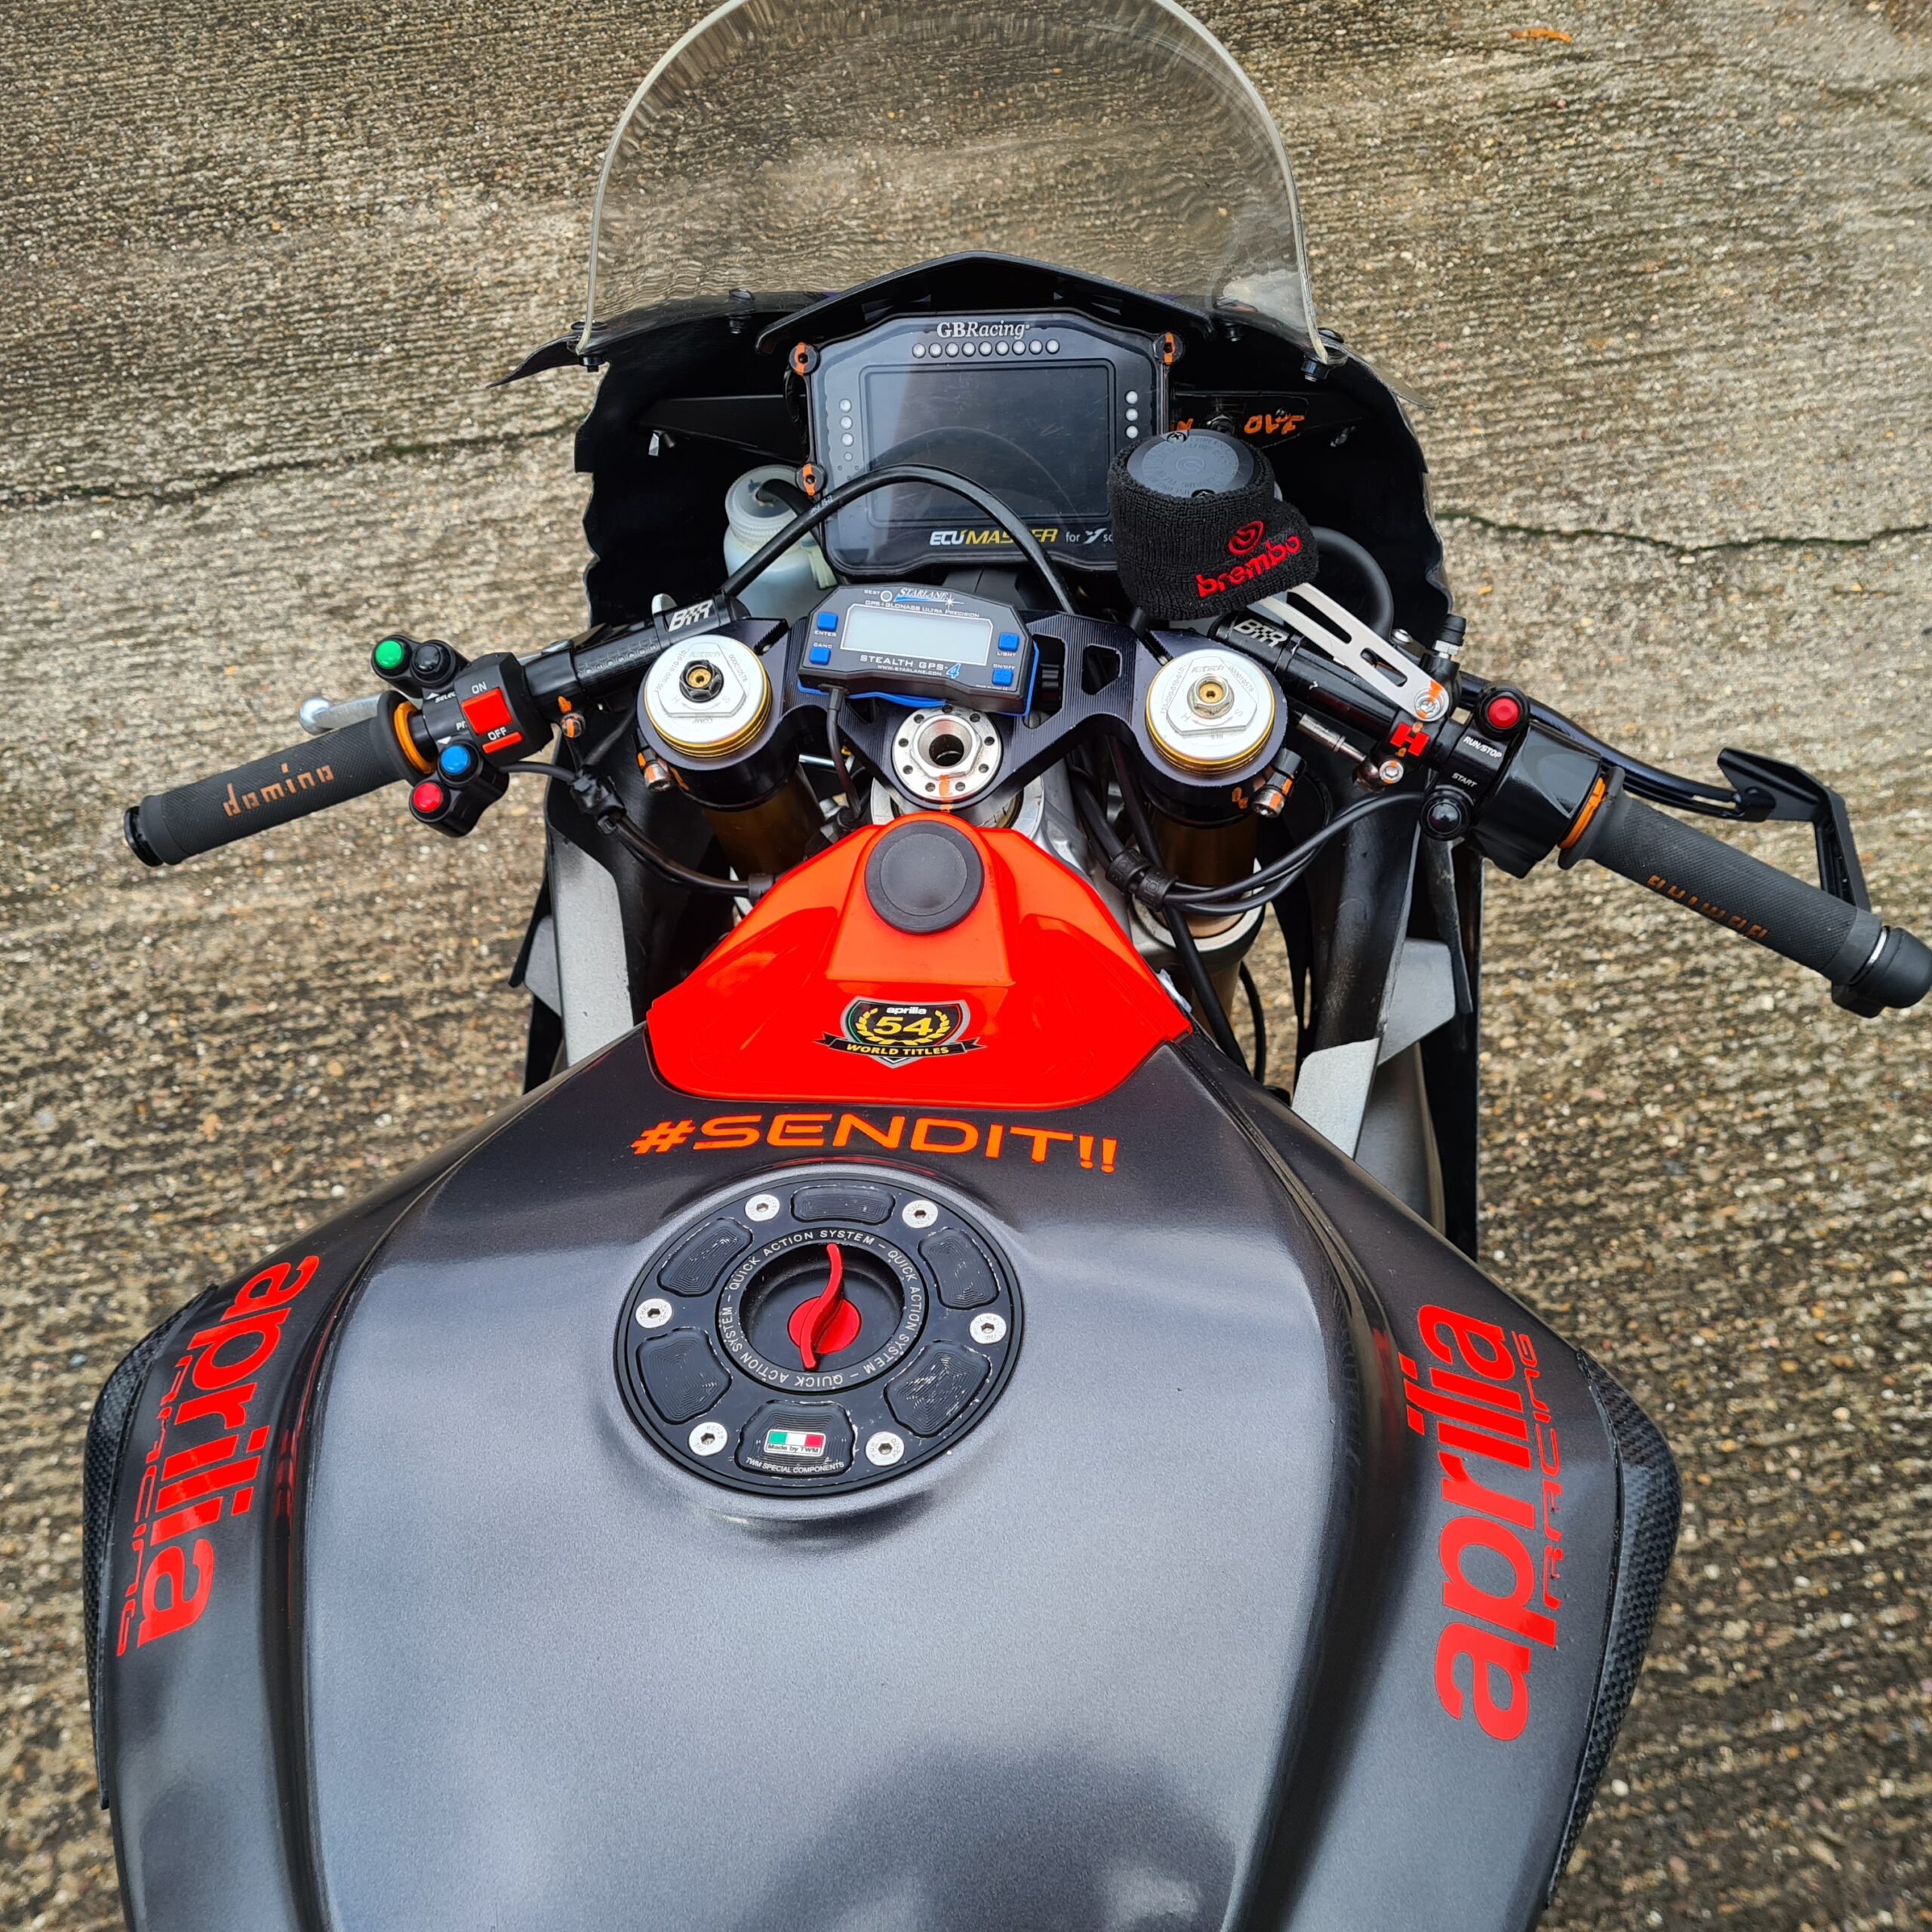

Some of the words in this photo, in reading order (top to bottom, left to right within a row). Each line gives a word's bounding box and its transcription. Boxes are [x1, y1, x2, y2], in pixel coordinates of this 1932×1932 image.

[937, 319, 1026, 340] GBRacing
[1065, 531, 1081, 543] for
[1195, 535, 1302, 598] brembo
[898, 587, 949, 600] STARLANE
[668, 599, 714, 632] BTR
[1233, 618, 1287, 648] BTR
[860, 654, 913, 668] STEALTH
[471, 681, 488, 695] ON
[487, 726, 508, 741] OFF
[1463, 735, 1503, 759] RUN/STOP
[1451, 771, 1478, 789] START
[886, 1006, 928, 1016] aprilia
[873, 1016, 934, 1036] 54
[846, 1043, 899, 1056] WORLD
[903, 1047, 949, 1056] TITLES
[631, 1112, 1118, 1174] #SENDIT!!
[762, 1231, 814, 1257] ACTION
[820, 1229, 875, 1246] SYSTEM
[728, 1257, 761, 1291] QUICK
[887, 1250, 918, 1282] QUICK
[905, 1285, 922, 1331] ACTION
[721, 1306, 743, 1352] SYSTEM
[863, 1333, 910, 1376] SYSTEM
[740, 1352, 789, 1384] ACTION
[794, 1374, 844, 1388] QUICK
[137, 1254, 319, 1649] aprilia
[746, 1457, 762, 1468] TWM
[761, 1462, 792, 1473] SPECIAL
[792, 1461, 844, 1474] COMPONENTS
[1512, 1330, 1564, 1611] RACING
[116, 1354, 193, 1657] RACING
[1398, 1303, 1558, 1743] aprilia
